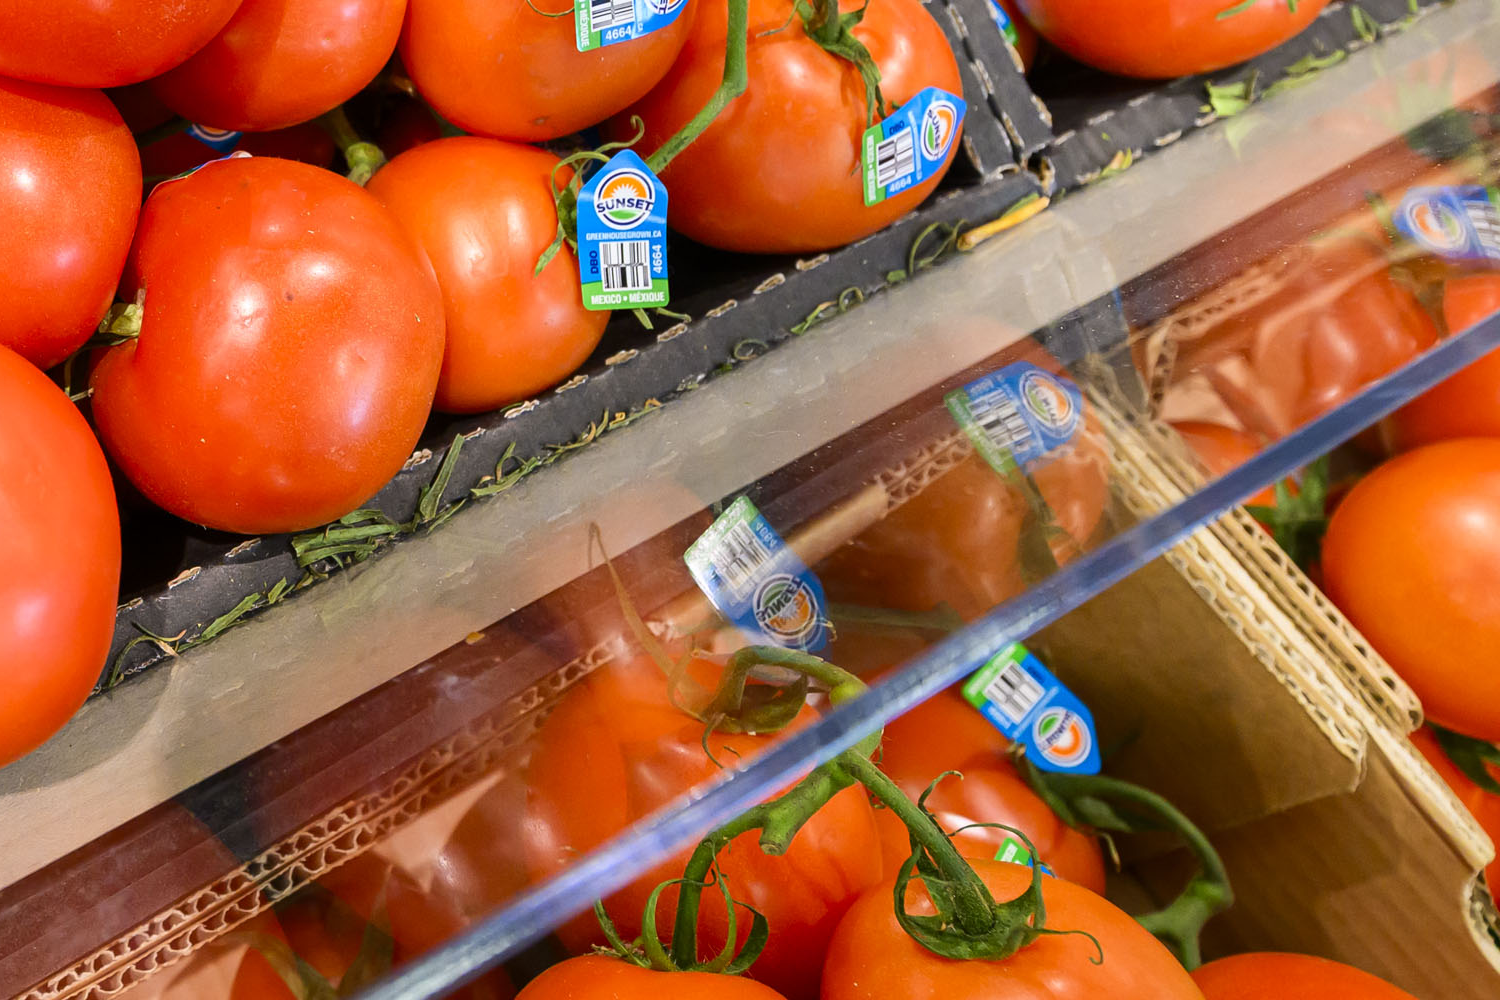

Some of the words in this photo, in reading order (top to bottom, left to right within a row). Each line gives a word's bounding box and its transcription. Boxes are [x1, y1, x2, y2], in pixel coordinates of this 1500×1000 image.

[605, 25, 632, 41] 4664
[596, 198, 654, 214] SUNSET
[586, 230, 662, 241] GREENHOUSEGROWN.CA
[589, 250, 599, 275] DBO
[652, 244, 663, 274] 4664
[591, 294, 622, 305] MEXICO
[629, 291, 665, 303] MÉXIQUE
